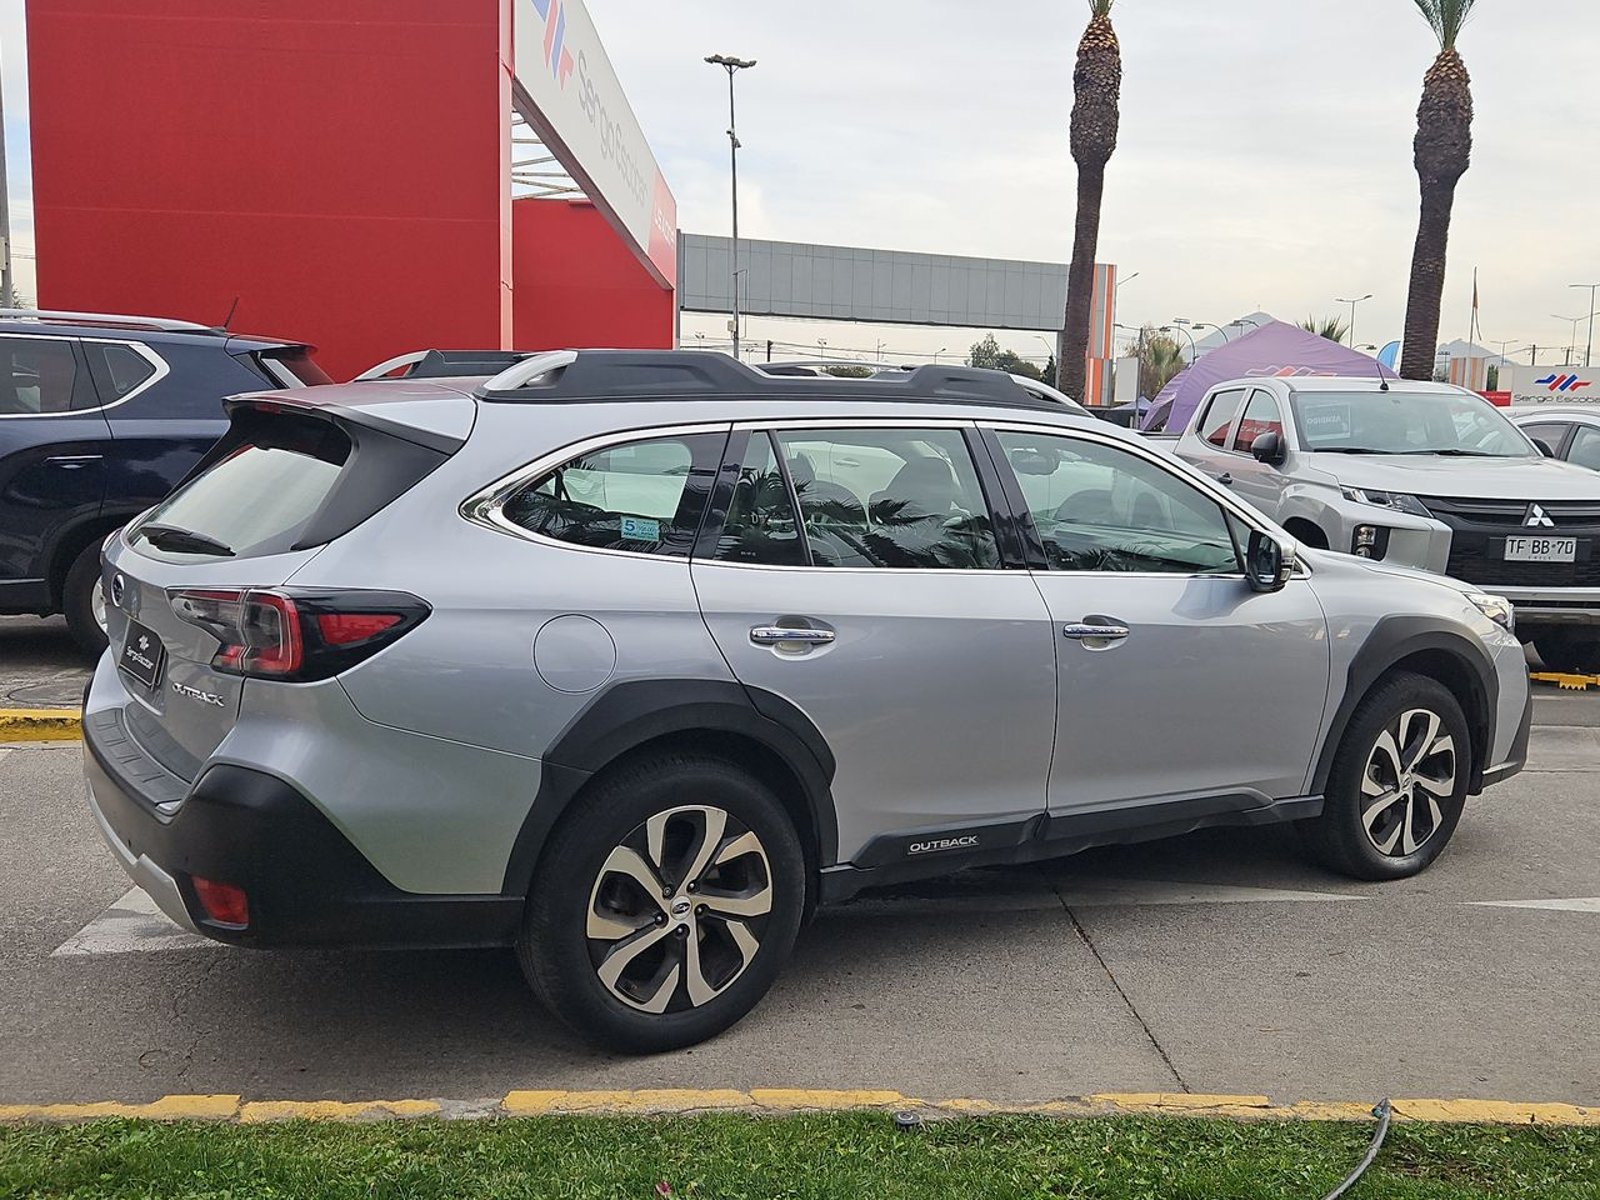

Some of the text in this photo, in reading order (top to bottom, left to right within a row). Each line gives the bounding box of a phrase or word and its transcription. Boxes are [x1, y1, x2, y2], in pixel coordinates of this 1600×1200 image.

[578, 49, 614, 160] Sergo
[1513, 394, 1554, 404] Sergo
[624, 520, 636, 531] 5
[909, 835, 978, 853] OUTBACK
